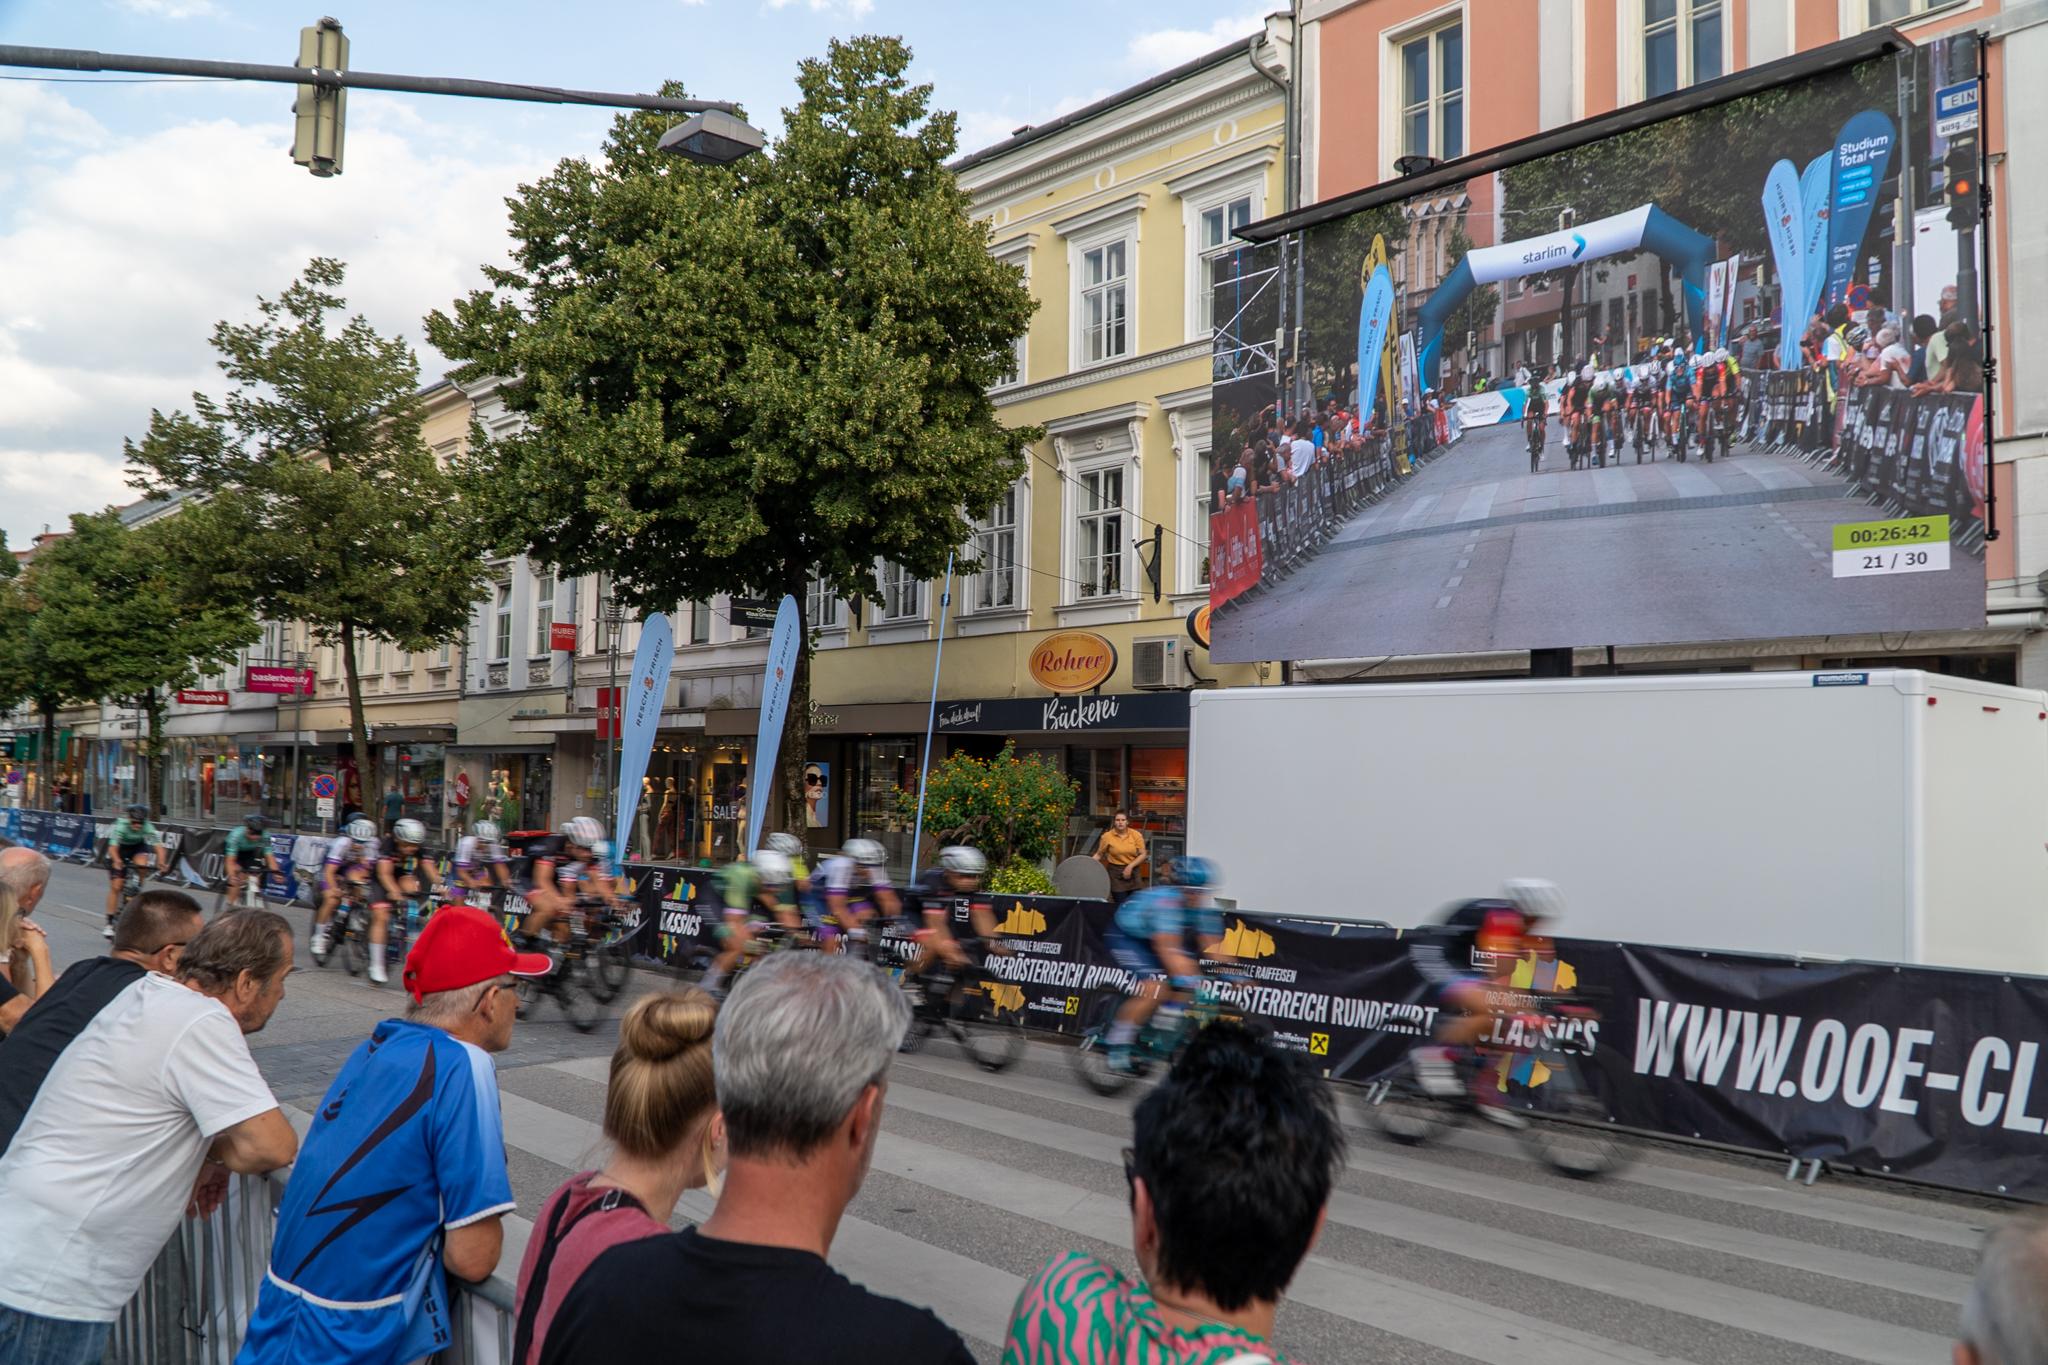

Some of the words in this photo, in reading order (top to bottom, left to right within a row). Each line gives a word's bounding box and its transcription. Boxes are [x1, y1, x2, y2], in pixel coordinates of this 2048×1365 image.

[1951, 91, 1975, 106] EIN
[1840, 135, 1888, 155] Studium
[1840, 150, 1868, 167] Total
[1523, 245, 1567, 264] starlim
[1850, 524, 1931, 543] 00:26:42
[1863, 556, 1884, 569] 21
[1890, 553, 1898, 569] /
[1905, 551, 1928, 566] 30
[1040, 649, 1104, 674] Rohrer
[768, 681, 779, 722] RESCH
[781, 623, 793, 665] FRISCH
[636, 690, 649, 728] RESCH
[649, 638, 663, 676] FRISCH
[1042, 695, 1120, 730] Bäckerei
[713, 805, 737, 820] SALE
[984, 952, 1085, 988] OBERÖSTERREICH
[1255, 965, 1298, 983] RAIFFEISEN
[1273, 1030, 1309, 1043] Raiffeisen
[1634, 998, 2048, 1134] WWW.OOE-CL
